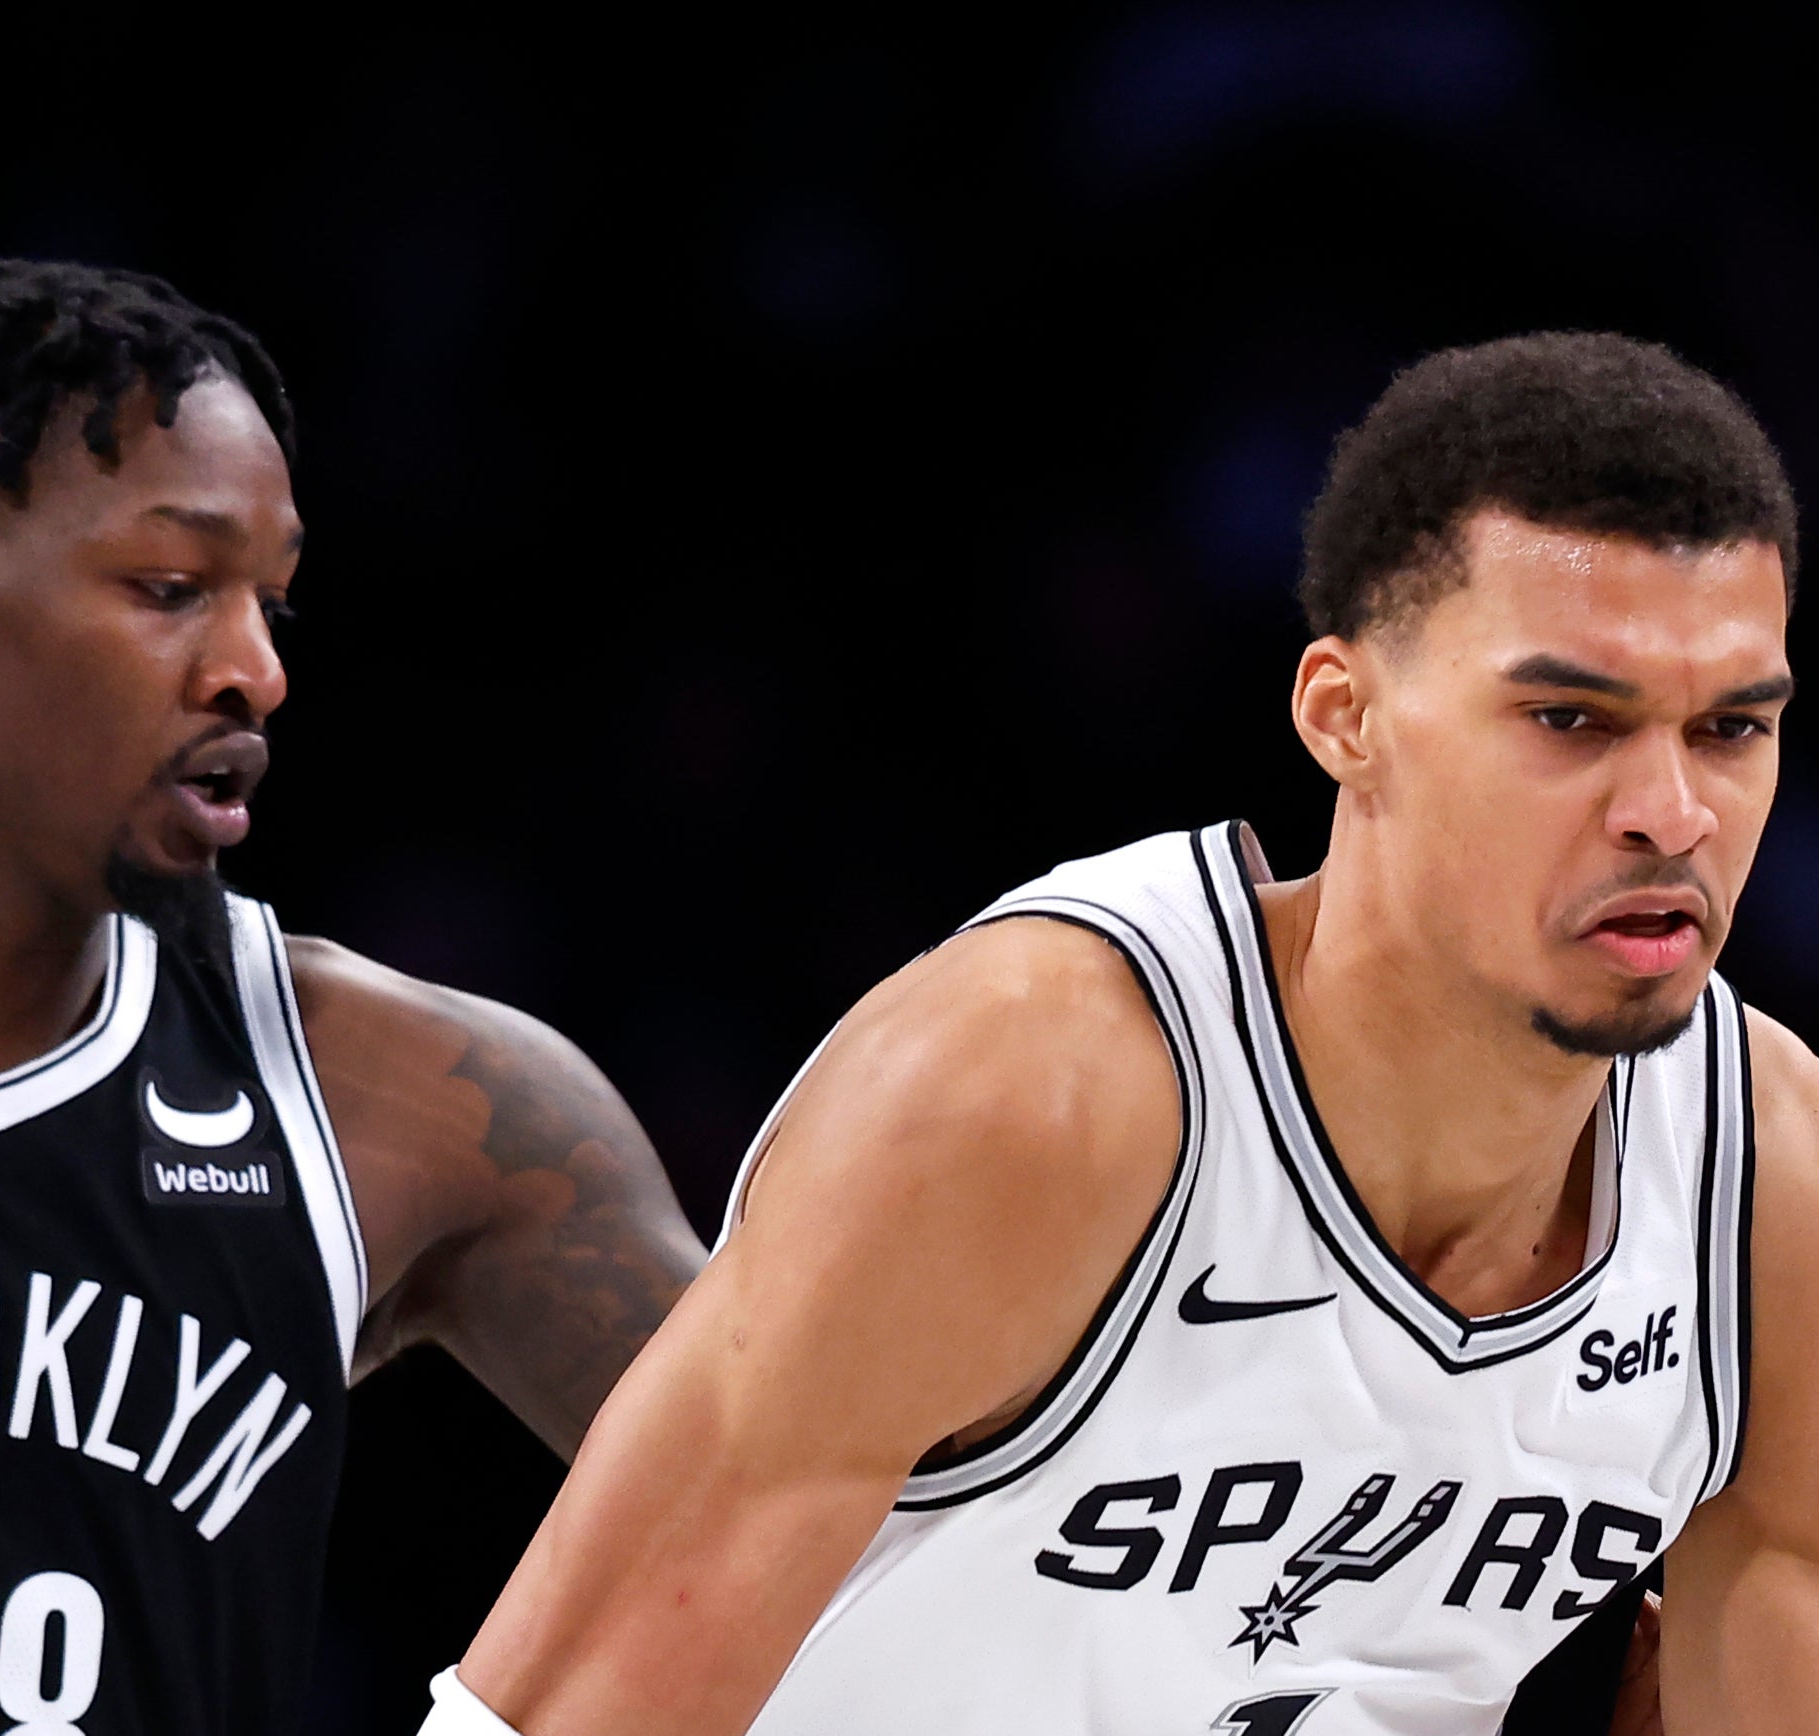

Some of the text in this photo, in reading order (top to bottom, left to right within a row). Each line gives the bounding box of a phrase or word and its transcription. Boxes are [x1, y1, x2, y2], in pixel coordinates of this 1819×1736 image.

[154, 1161, 270, 1194] Webull
[1576, 1306, 1680, 1392] Self.
[1034, 1461, 1663, 1665] SPURS
